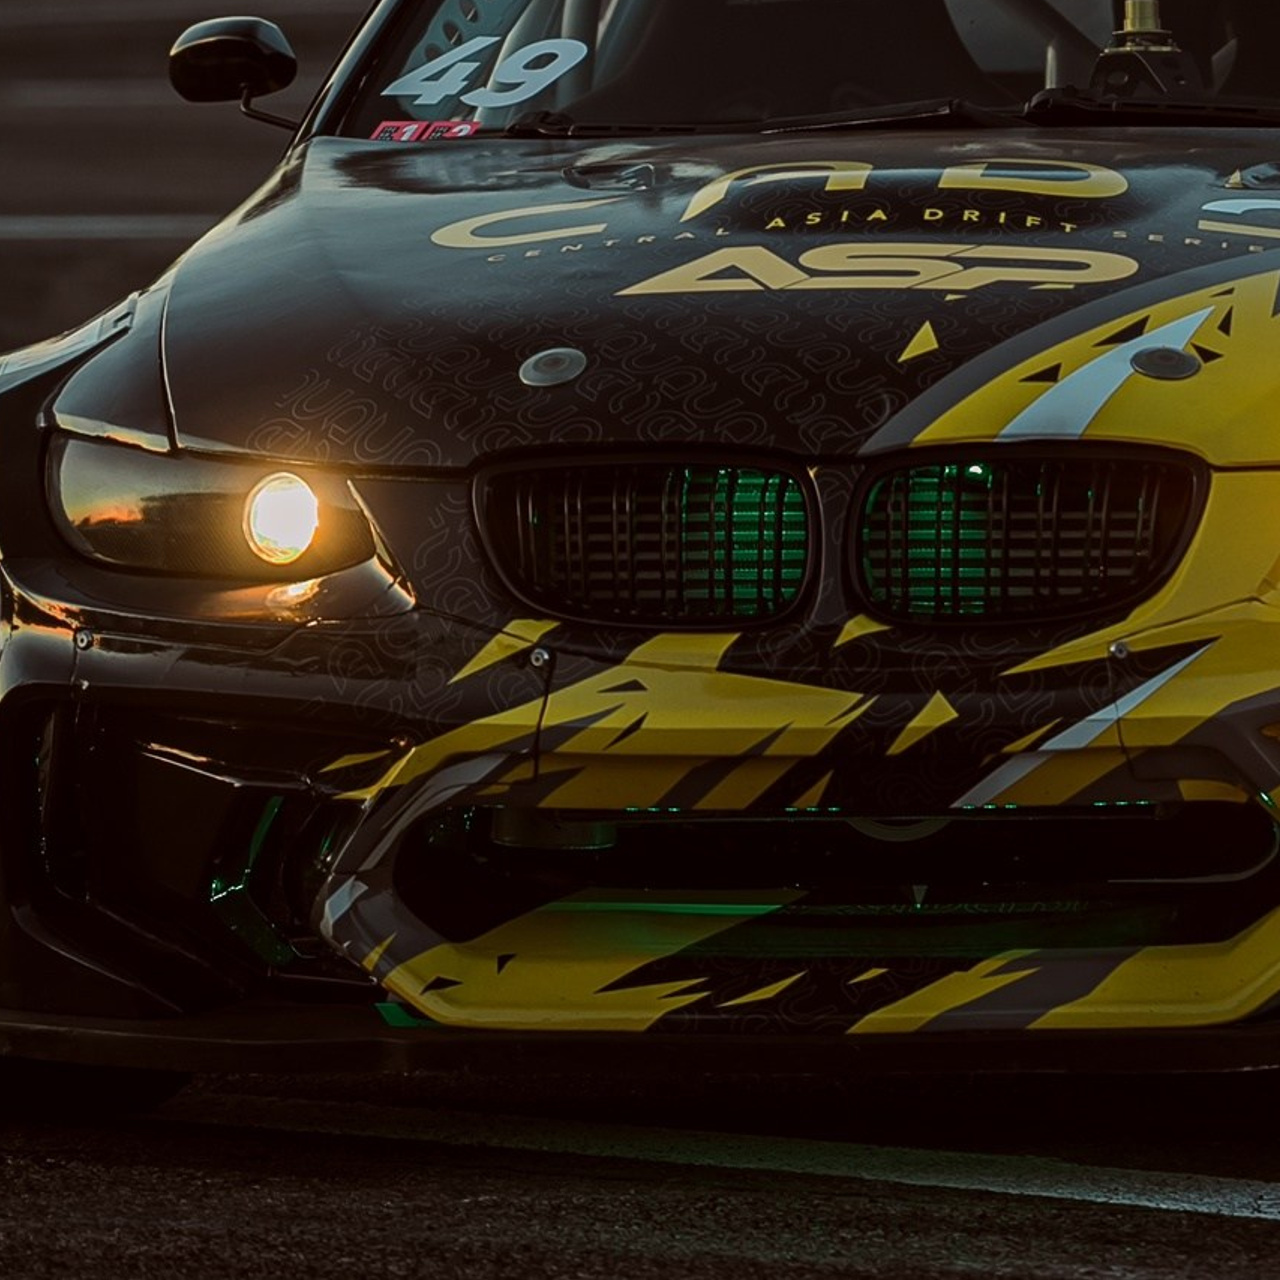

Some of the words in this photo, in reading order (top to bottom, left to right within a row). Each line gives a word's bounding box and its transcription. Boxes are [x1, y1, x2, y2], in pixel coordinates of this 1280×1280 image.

[380, 35, 589, 108] 49
[487, 226, 731, 263] CENTRAL
[764, 208, 888, 231] ASIA
[922, 208, 1079, 233] DRIFT
[613, 242, 1140, 297] ASP
